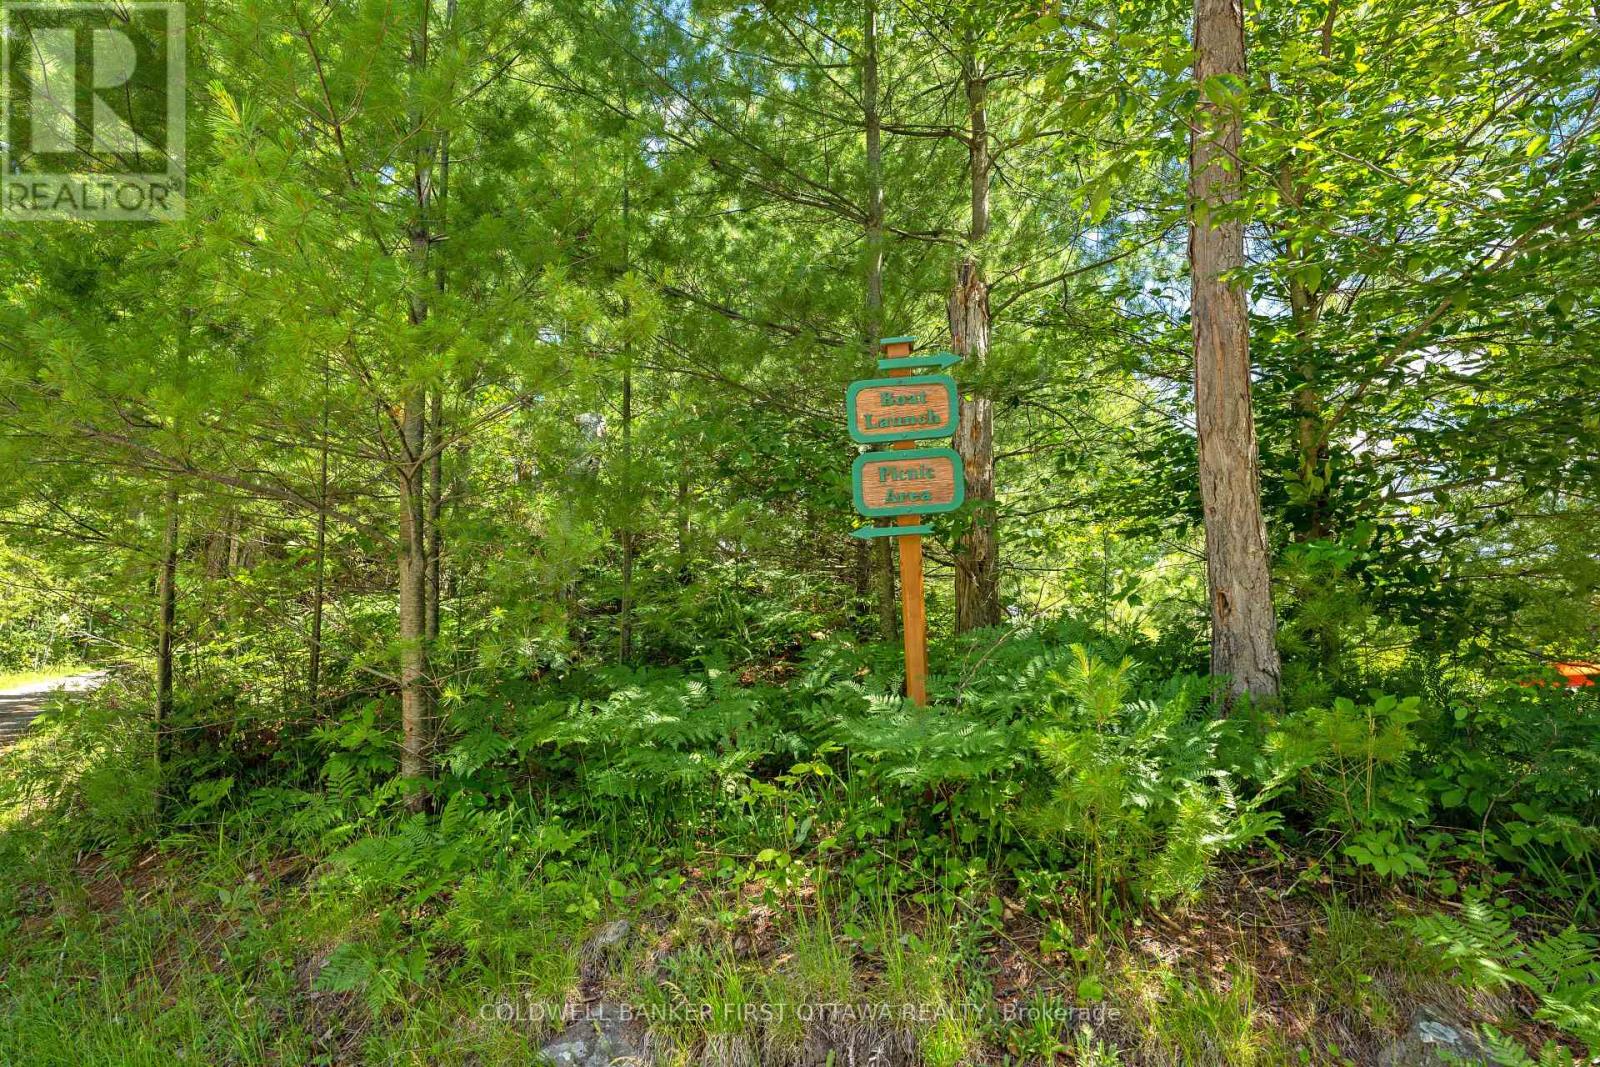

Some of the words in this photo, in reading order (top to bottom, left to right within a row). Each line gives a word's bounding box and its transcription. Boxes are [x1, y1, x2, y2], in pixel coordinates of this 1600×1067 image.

[881, 391, 927, 406] Boat
[864, 409, 941, 430] Launch
[879, 464, 935, 483] Picnic
[885, 488, 932, 503] Area
